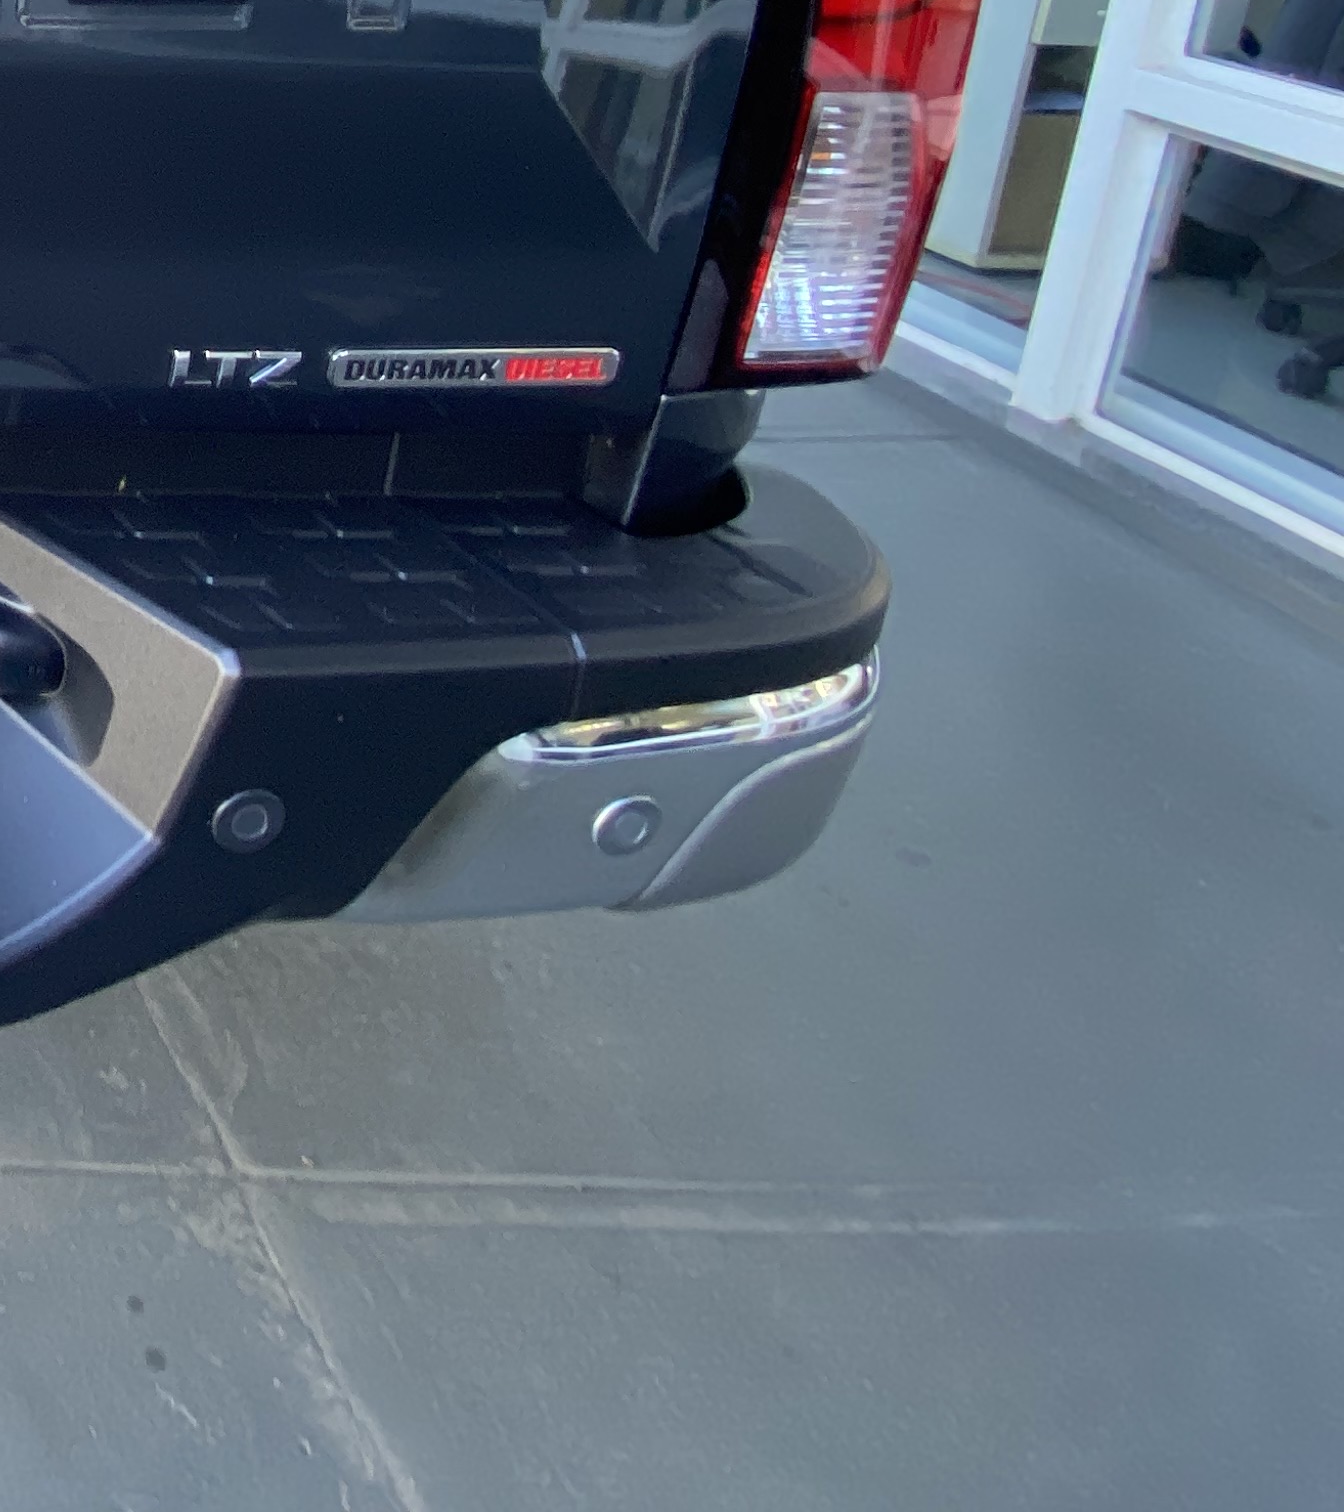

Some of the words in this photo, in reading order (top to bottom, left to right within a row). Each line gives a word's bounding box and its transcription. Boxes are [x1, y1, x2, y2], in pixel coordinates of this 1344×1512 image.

[169, 349, 303, 387] LTZ
[343, 359, 501, 381] DURAMAX
[506, 358, 607, 381] DIESEL
